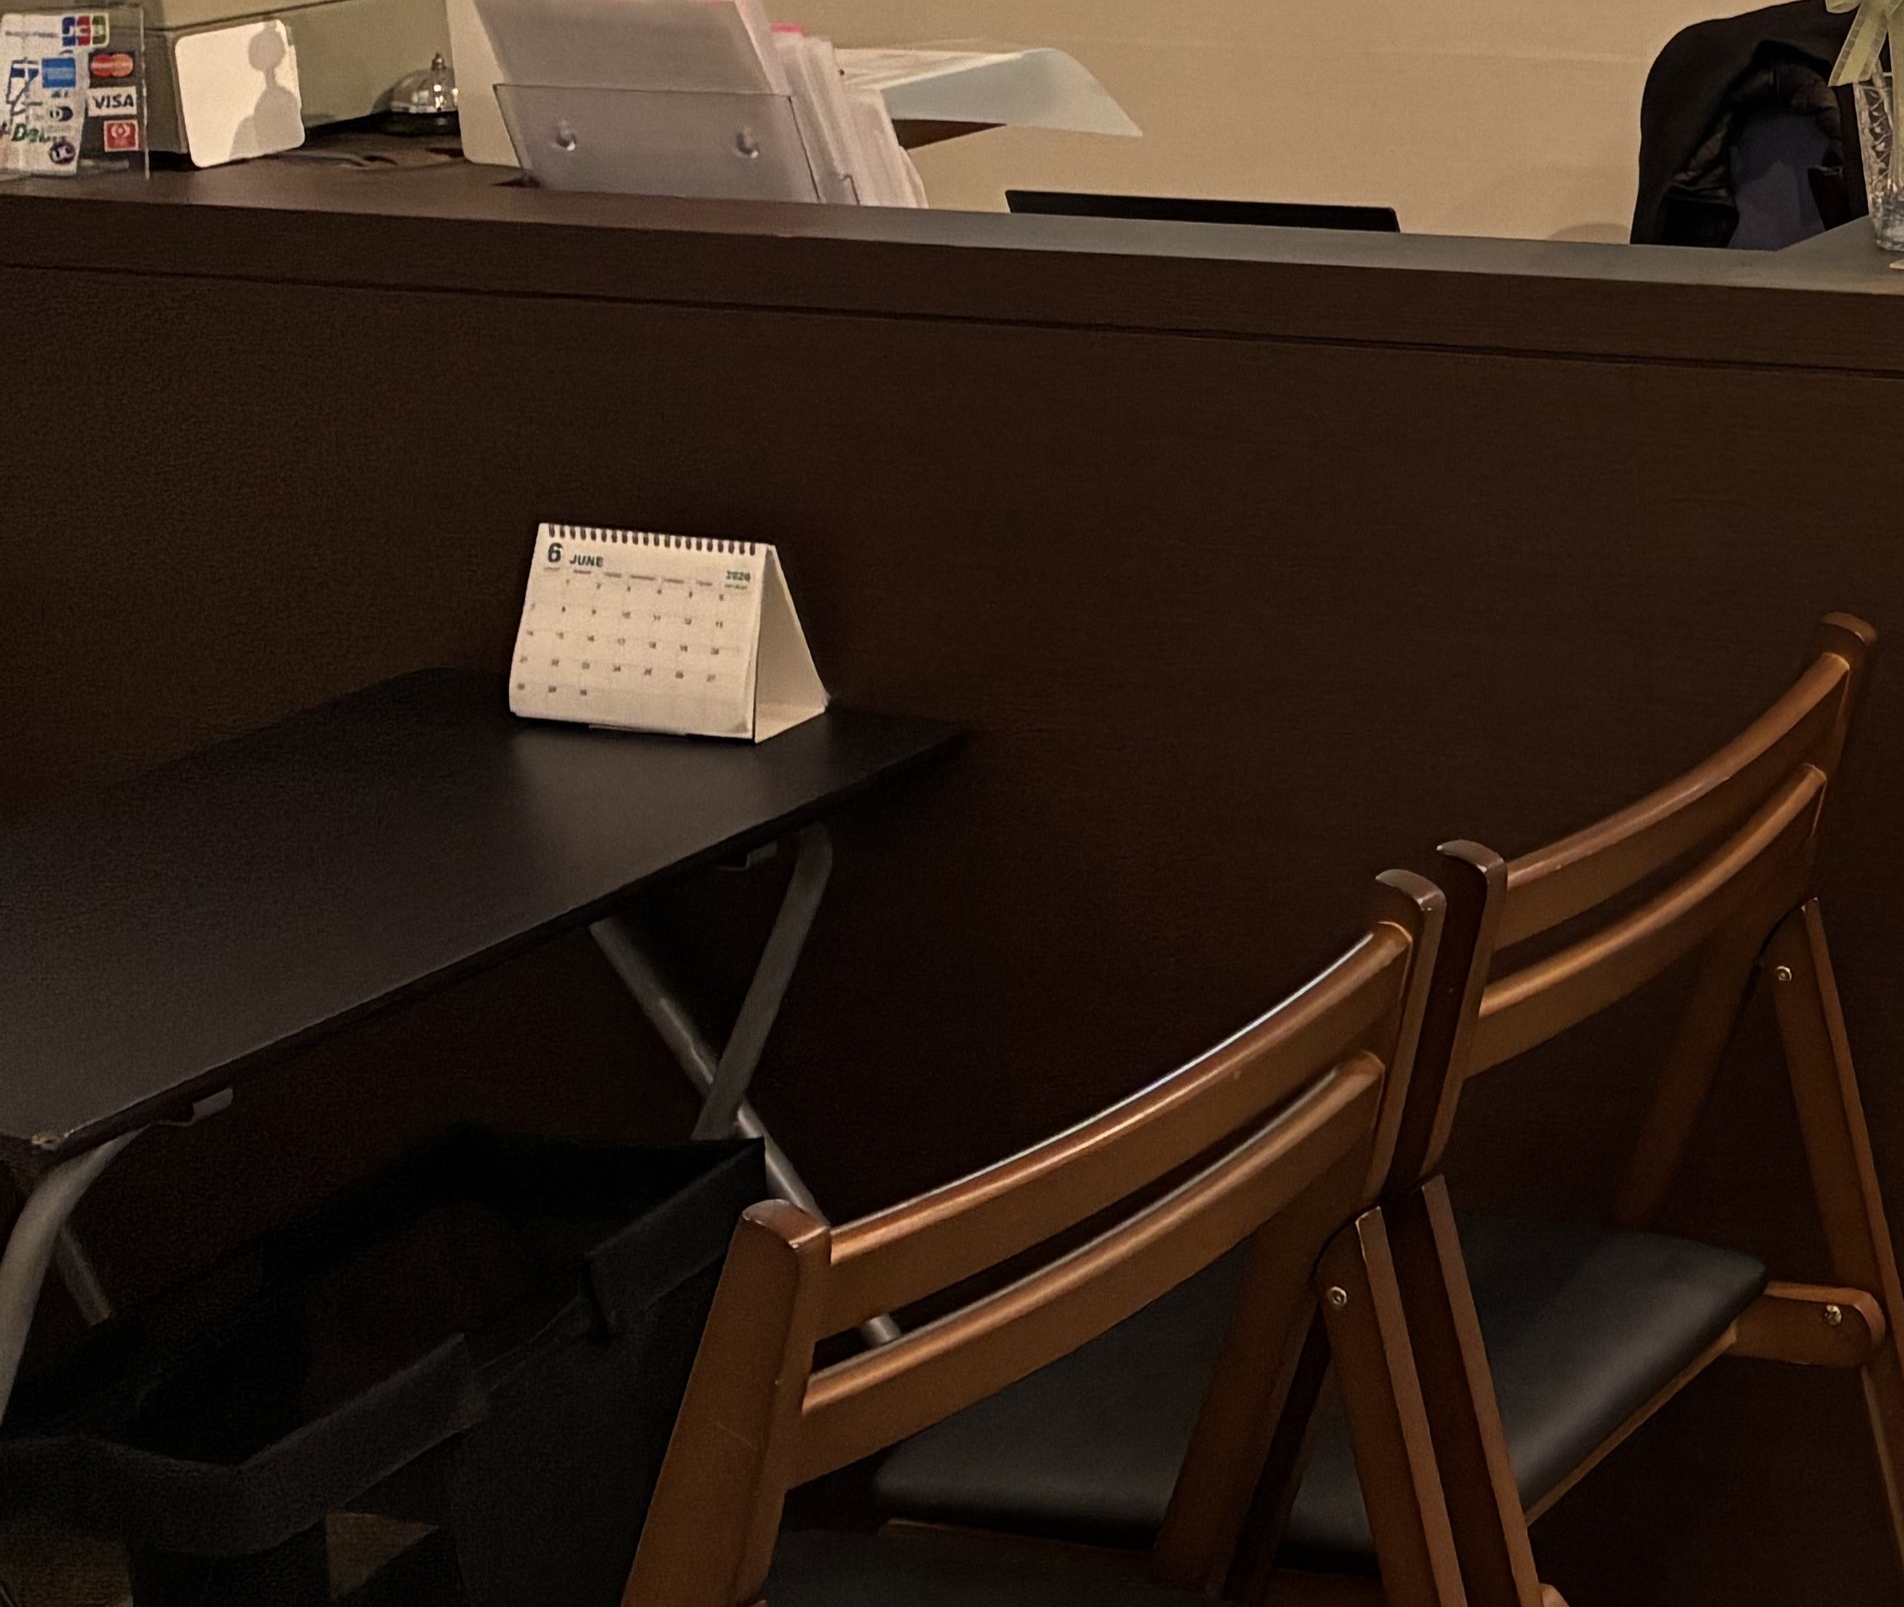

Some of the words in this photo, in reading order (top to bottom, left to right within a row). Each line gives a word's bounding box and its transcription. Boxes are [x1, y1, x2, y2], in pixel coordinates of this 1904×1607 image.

[94, 93, 135, 110] VISA
[547, 542, 562, 564] 6
[569, 554, 604, 567] JUNE
